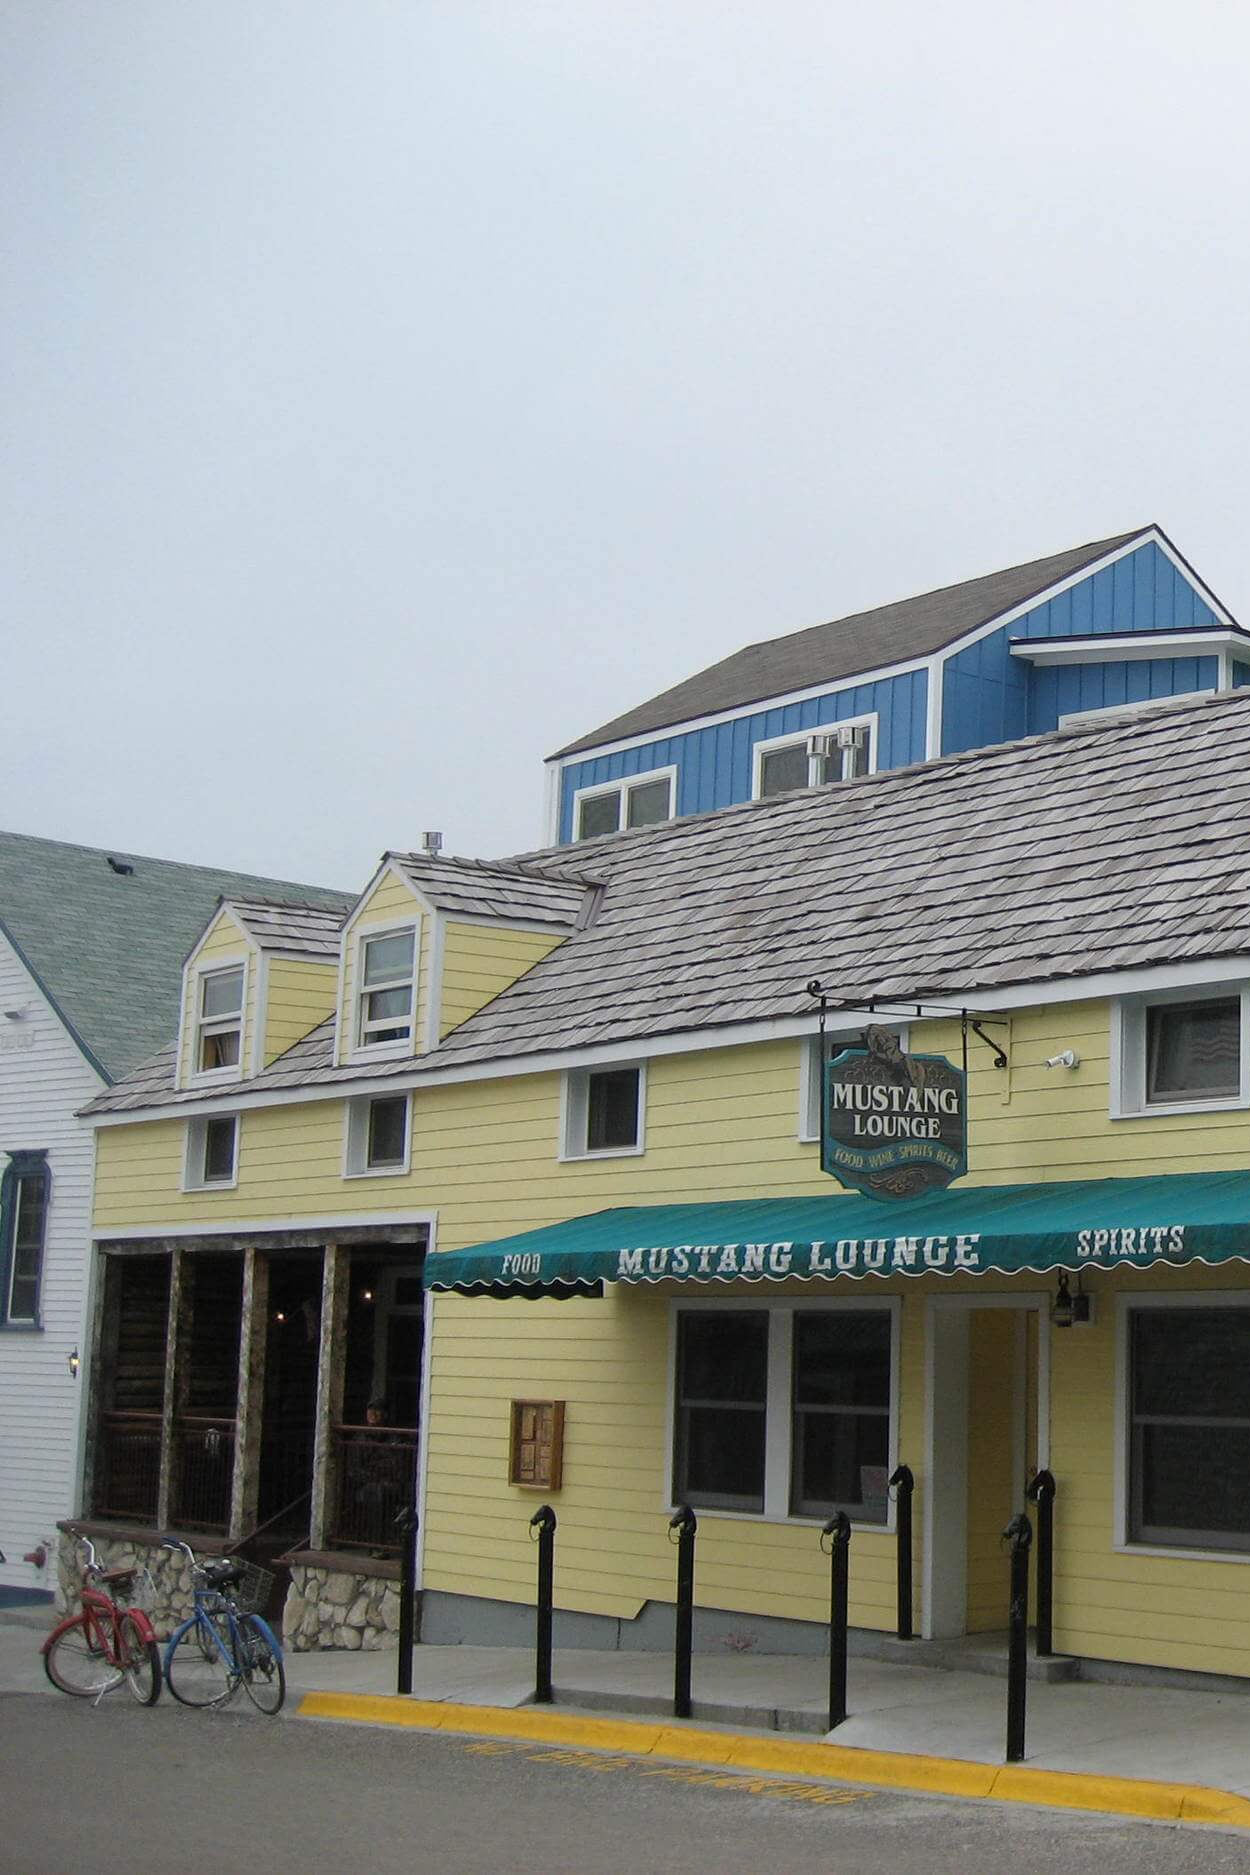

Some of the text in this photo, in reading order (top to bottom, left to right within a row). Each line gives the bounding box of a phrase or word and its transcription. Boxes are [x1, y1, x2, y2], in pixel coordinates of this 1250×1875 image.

[832, 1083, 959, 1114] MUSTANG
[854, 1114, 942, 1138] LOUNGE
[834, 1148, 864, 1168] FOOD
[898, 1144, 933, 1159] SPIRITS
[502, 1225, 1185, 1275] FOOD MUSTANG LOUNGE SPIRITS
